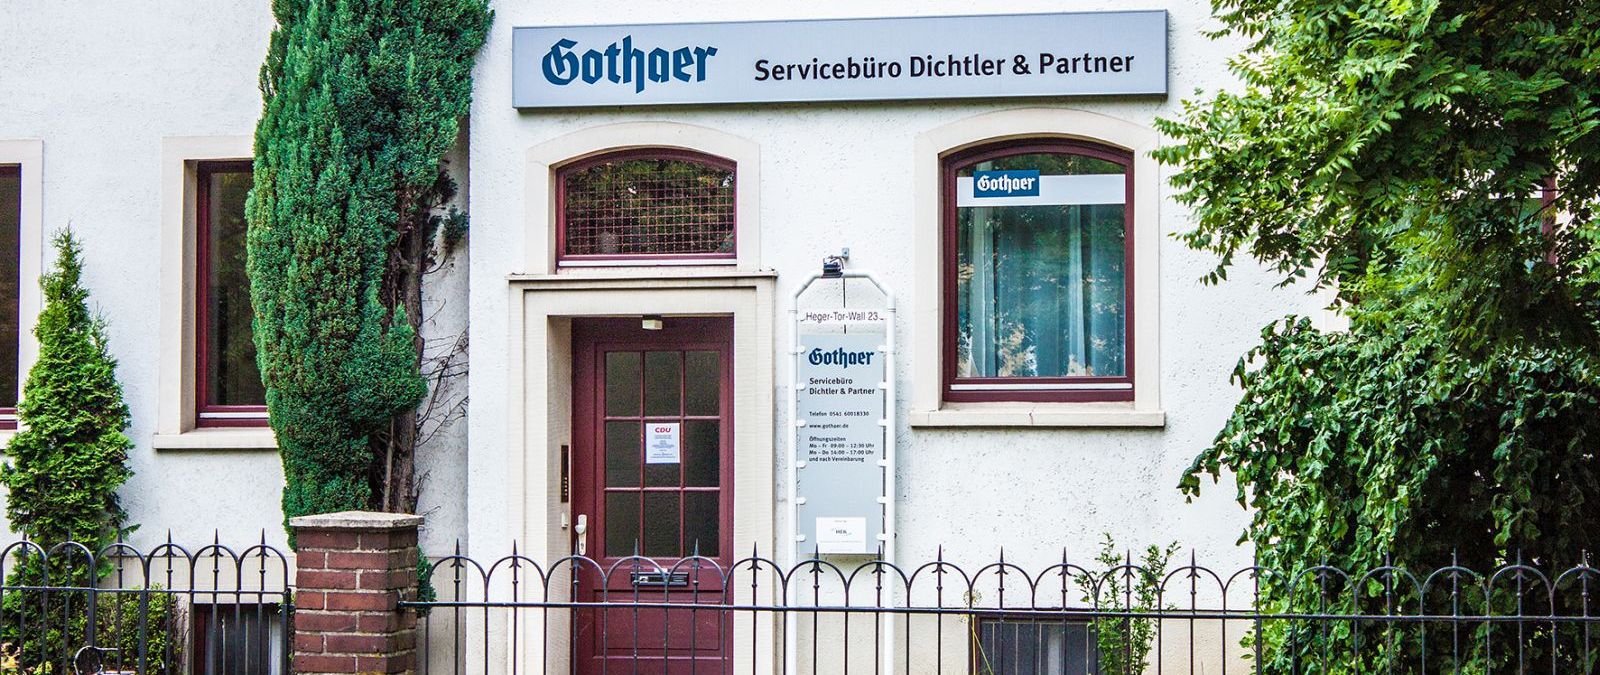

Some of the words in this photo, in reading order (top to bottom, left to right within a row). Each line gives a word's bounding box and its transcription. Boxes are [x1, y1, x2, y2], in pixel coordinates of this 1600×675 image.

[541, 35, 718, 94] Gothaer
[754, 54, 902, 81] Servicebüro
[909, 54, 1006, 78] Dichtler
[1012, 54, 1032, 76] &
[1039, 51, 1135, 75] Partner
[977, 174, 1036, 194] Gothaer
[806, 312, 866, 323] Heger-Tor-Wall
[868, 312, 878, 321] 23
[808, 347, 875, 369] Gothaer
[809, 377, 853, 385] Servicebüro
